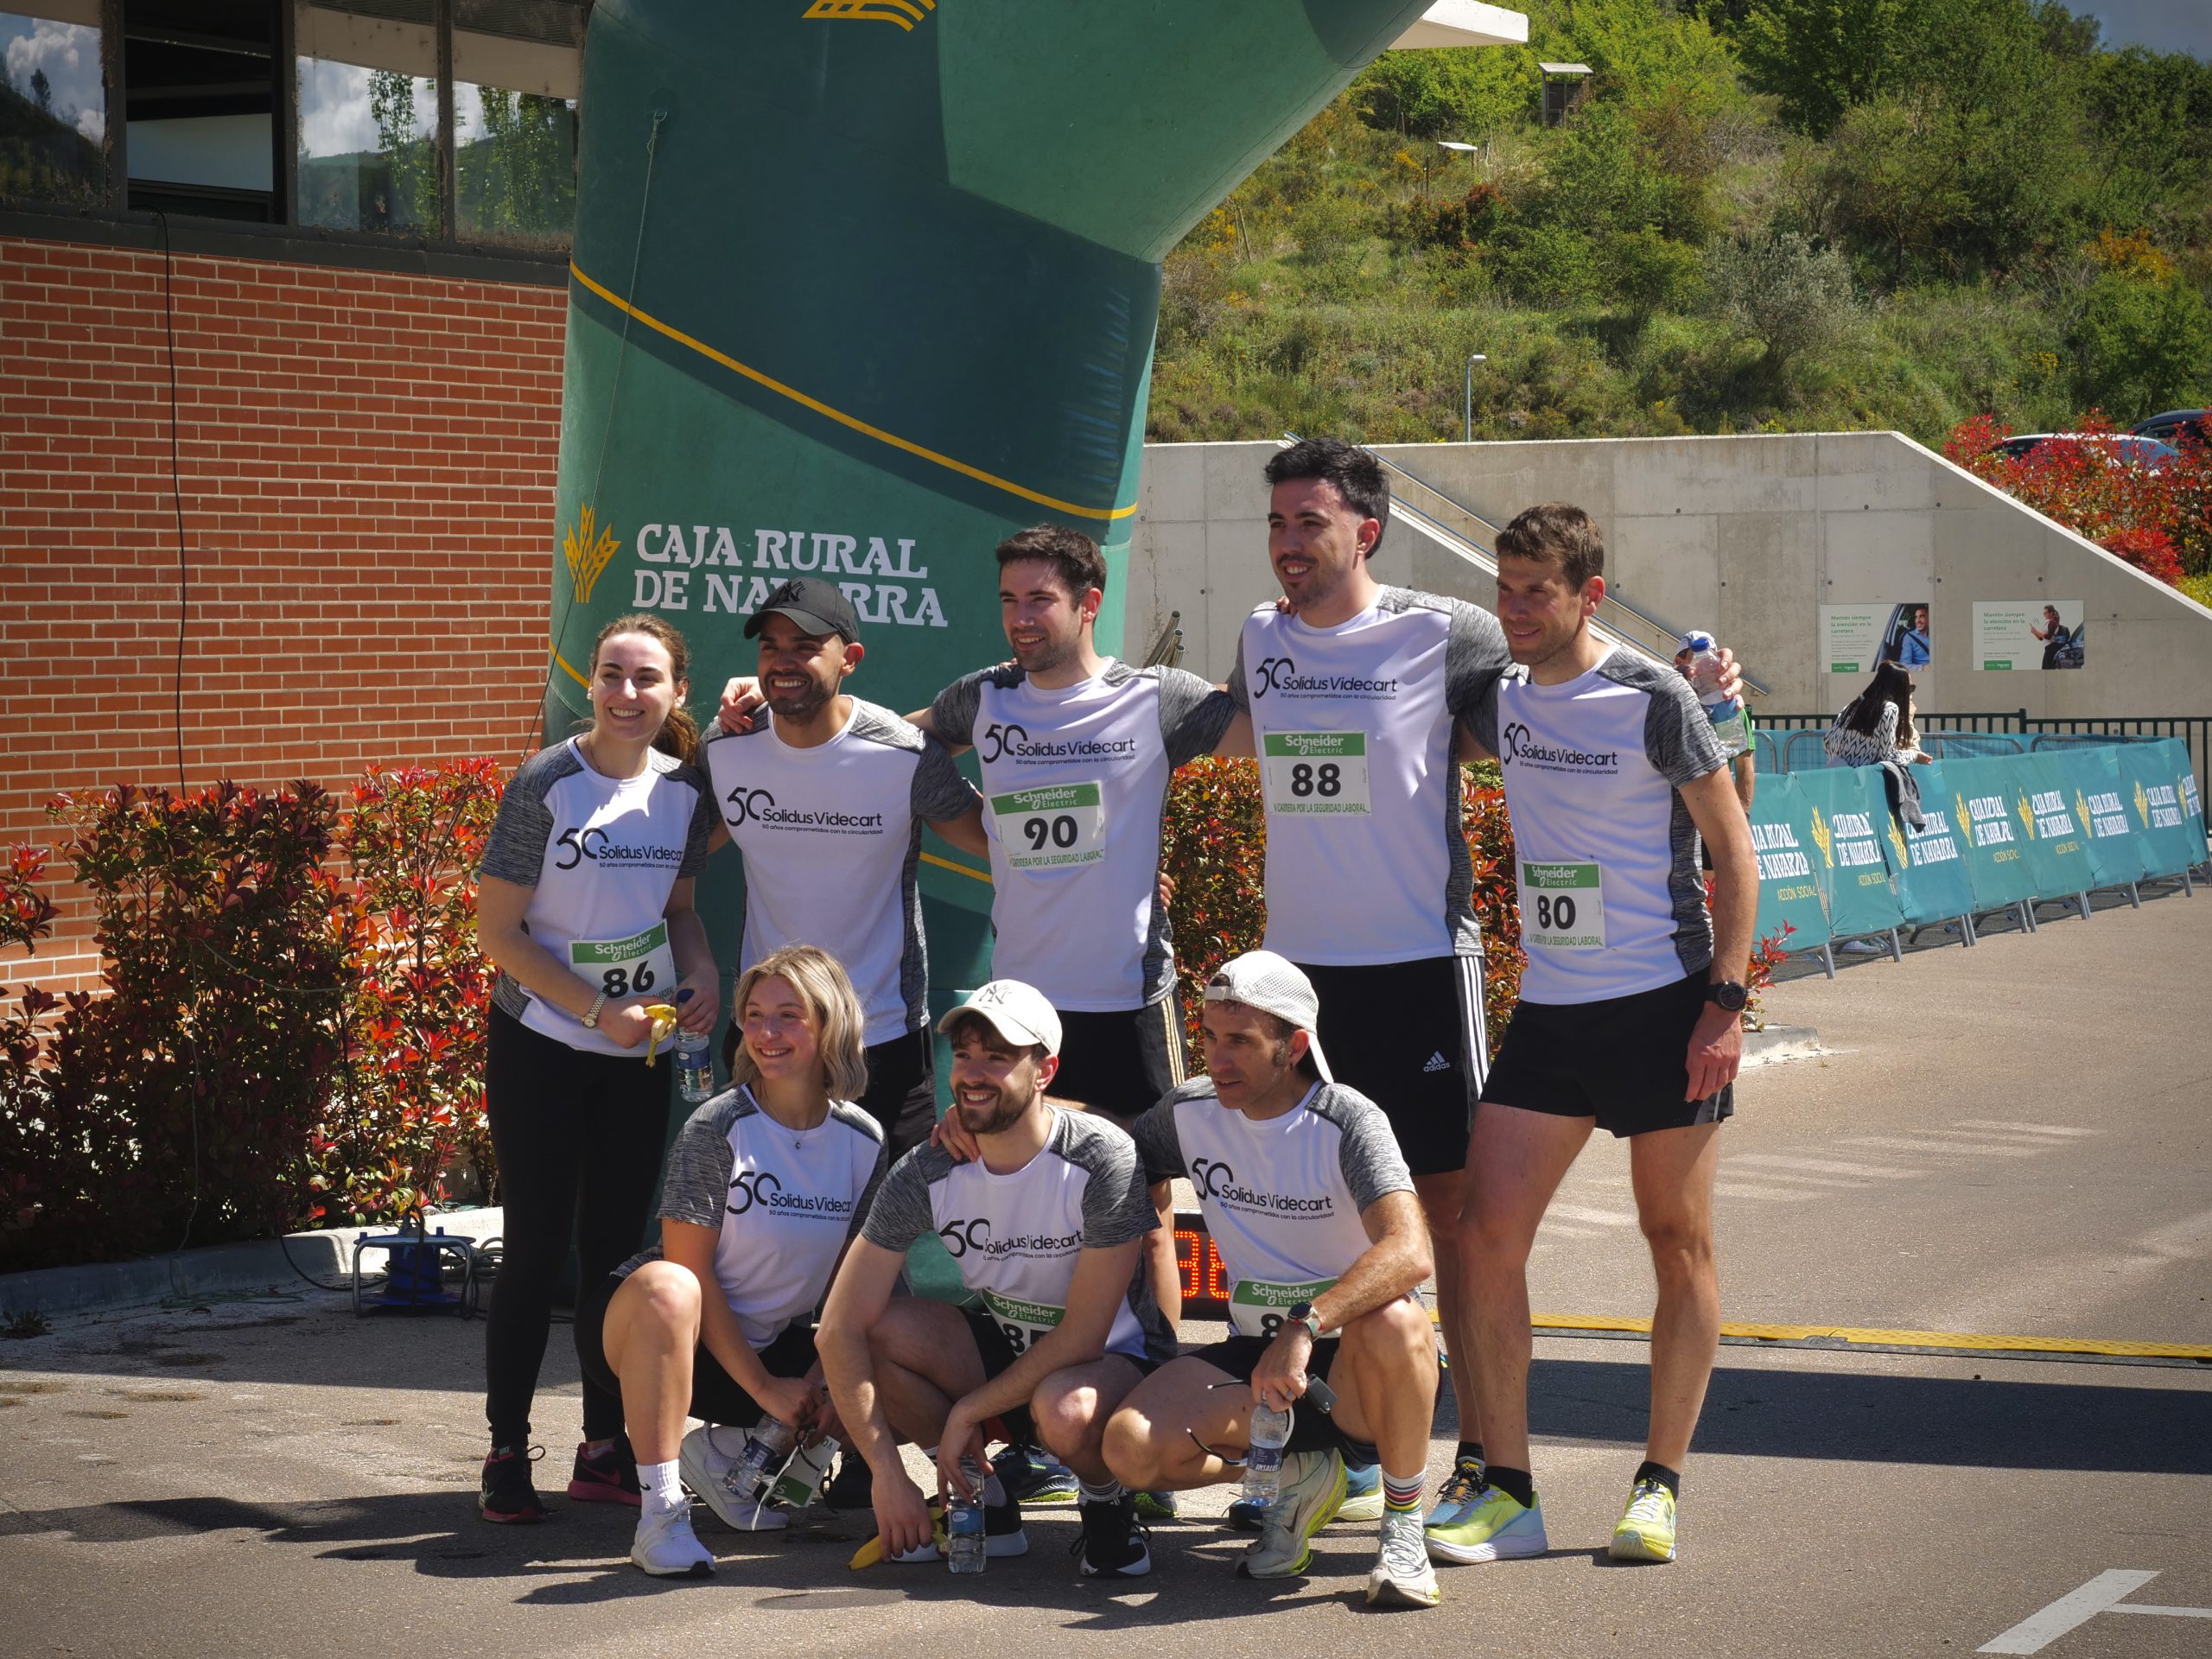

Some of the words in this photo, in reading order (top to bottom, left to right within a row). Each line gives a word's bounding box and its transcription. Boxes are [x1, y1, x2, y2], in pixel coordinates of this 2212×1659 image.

[637, 524, 742, 569] CAJA
[753, 530, 927, 578] RURAL
[632, 569, 690, 610] DE
[703, 574, 948, 626] NARRA
[1254, 658, 1294, 698] 50
[982, 723, 1028, 764] 50
[1285, 734, 1344, 747] Schneider
[1503, 722, 1529, 765] 50
[1013, 788, 1077, 804] Schneider
[1291, 763, 1341, 797] 88
[727, 786, 775, 827] 50
[1042, 798, 1077, 808] Electric
[1343, 803, 1367, 812] LABORAL
[556, 827, 609, 869] 50
[1024, 815, 1078, 850] 90
[1531, 866, 1578, 878] Schneider
[1538, 895, 1576, 930] 80
[594, 934, 652, 955] Schneider
[623, 944, 652, 958] Electric
[1578, 935, 1601, 945] LABORAL
[603, 959, 655, 998] 86
[1423, 1062, 1450, 1071] adidas
[726, 1171, 781, 1215] 50
[1192, 1157, 1234, 1201] 50
[994, 1296, 1056, 1318] Schneider
[1252, 1284, 1316, 1299] Schneider
[1020, 1313, 1056, 1325] Electric
